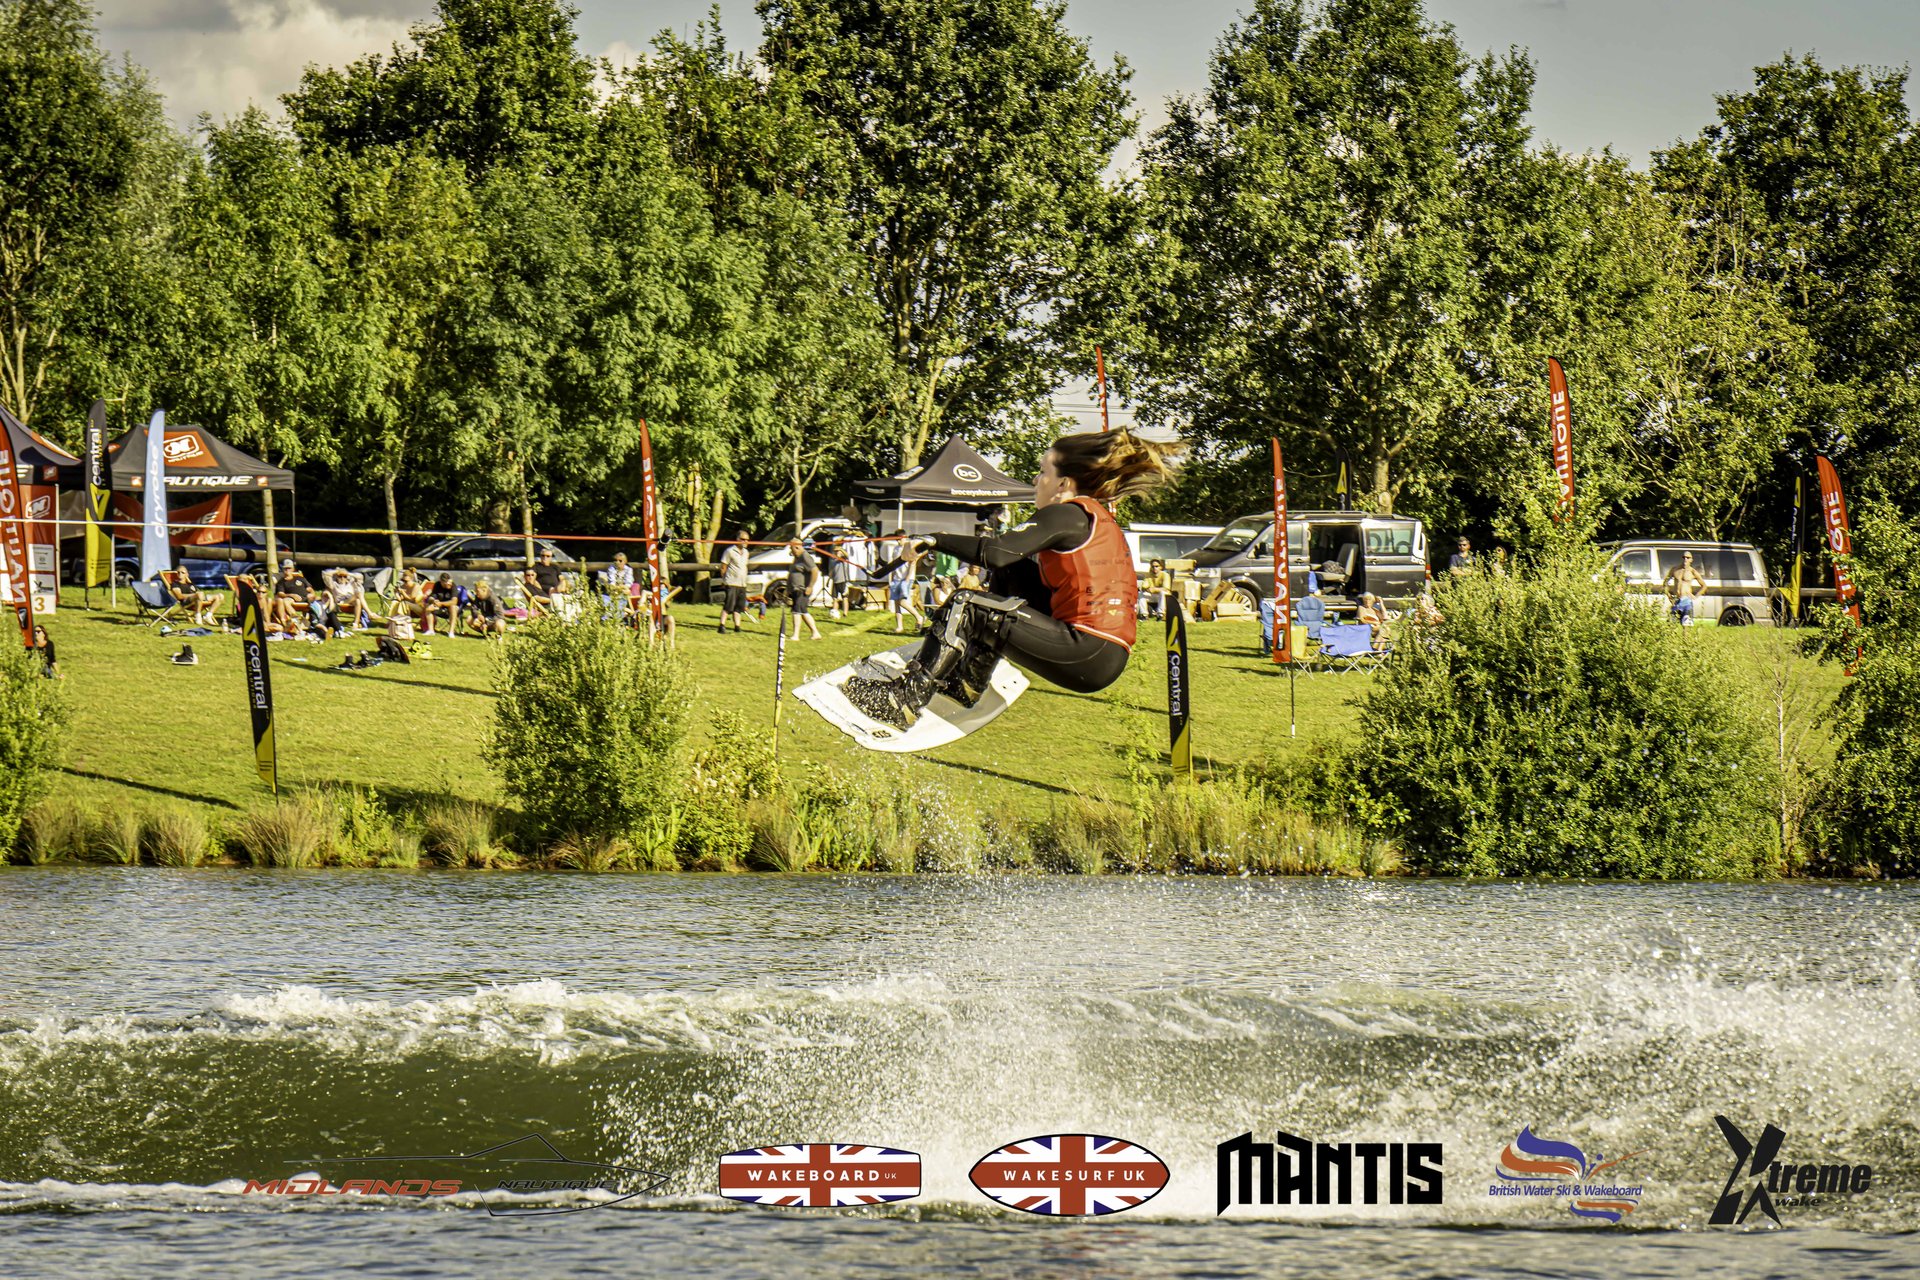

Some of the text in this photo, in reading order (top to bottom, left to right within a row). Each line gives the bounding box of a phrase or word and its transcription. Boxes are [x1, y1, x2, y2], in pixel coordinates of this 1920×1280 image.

[90, 428, 102, 486] central
[163, 475, 251, 487] AUTIQUE
[151, 445, 165, 538] dryrobe
[34, 596, 46, 612] 3
[250, 644, 268, 709] central
[1171, 654, 1183, 716] central
